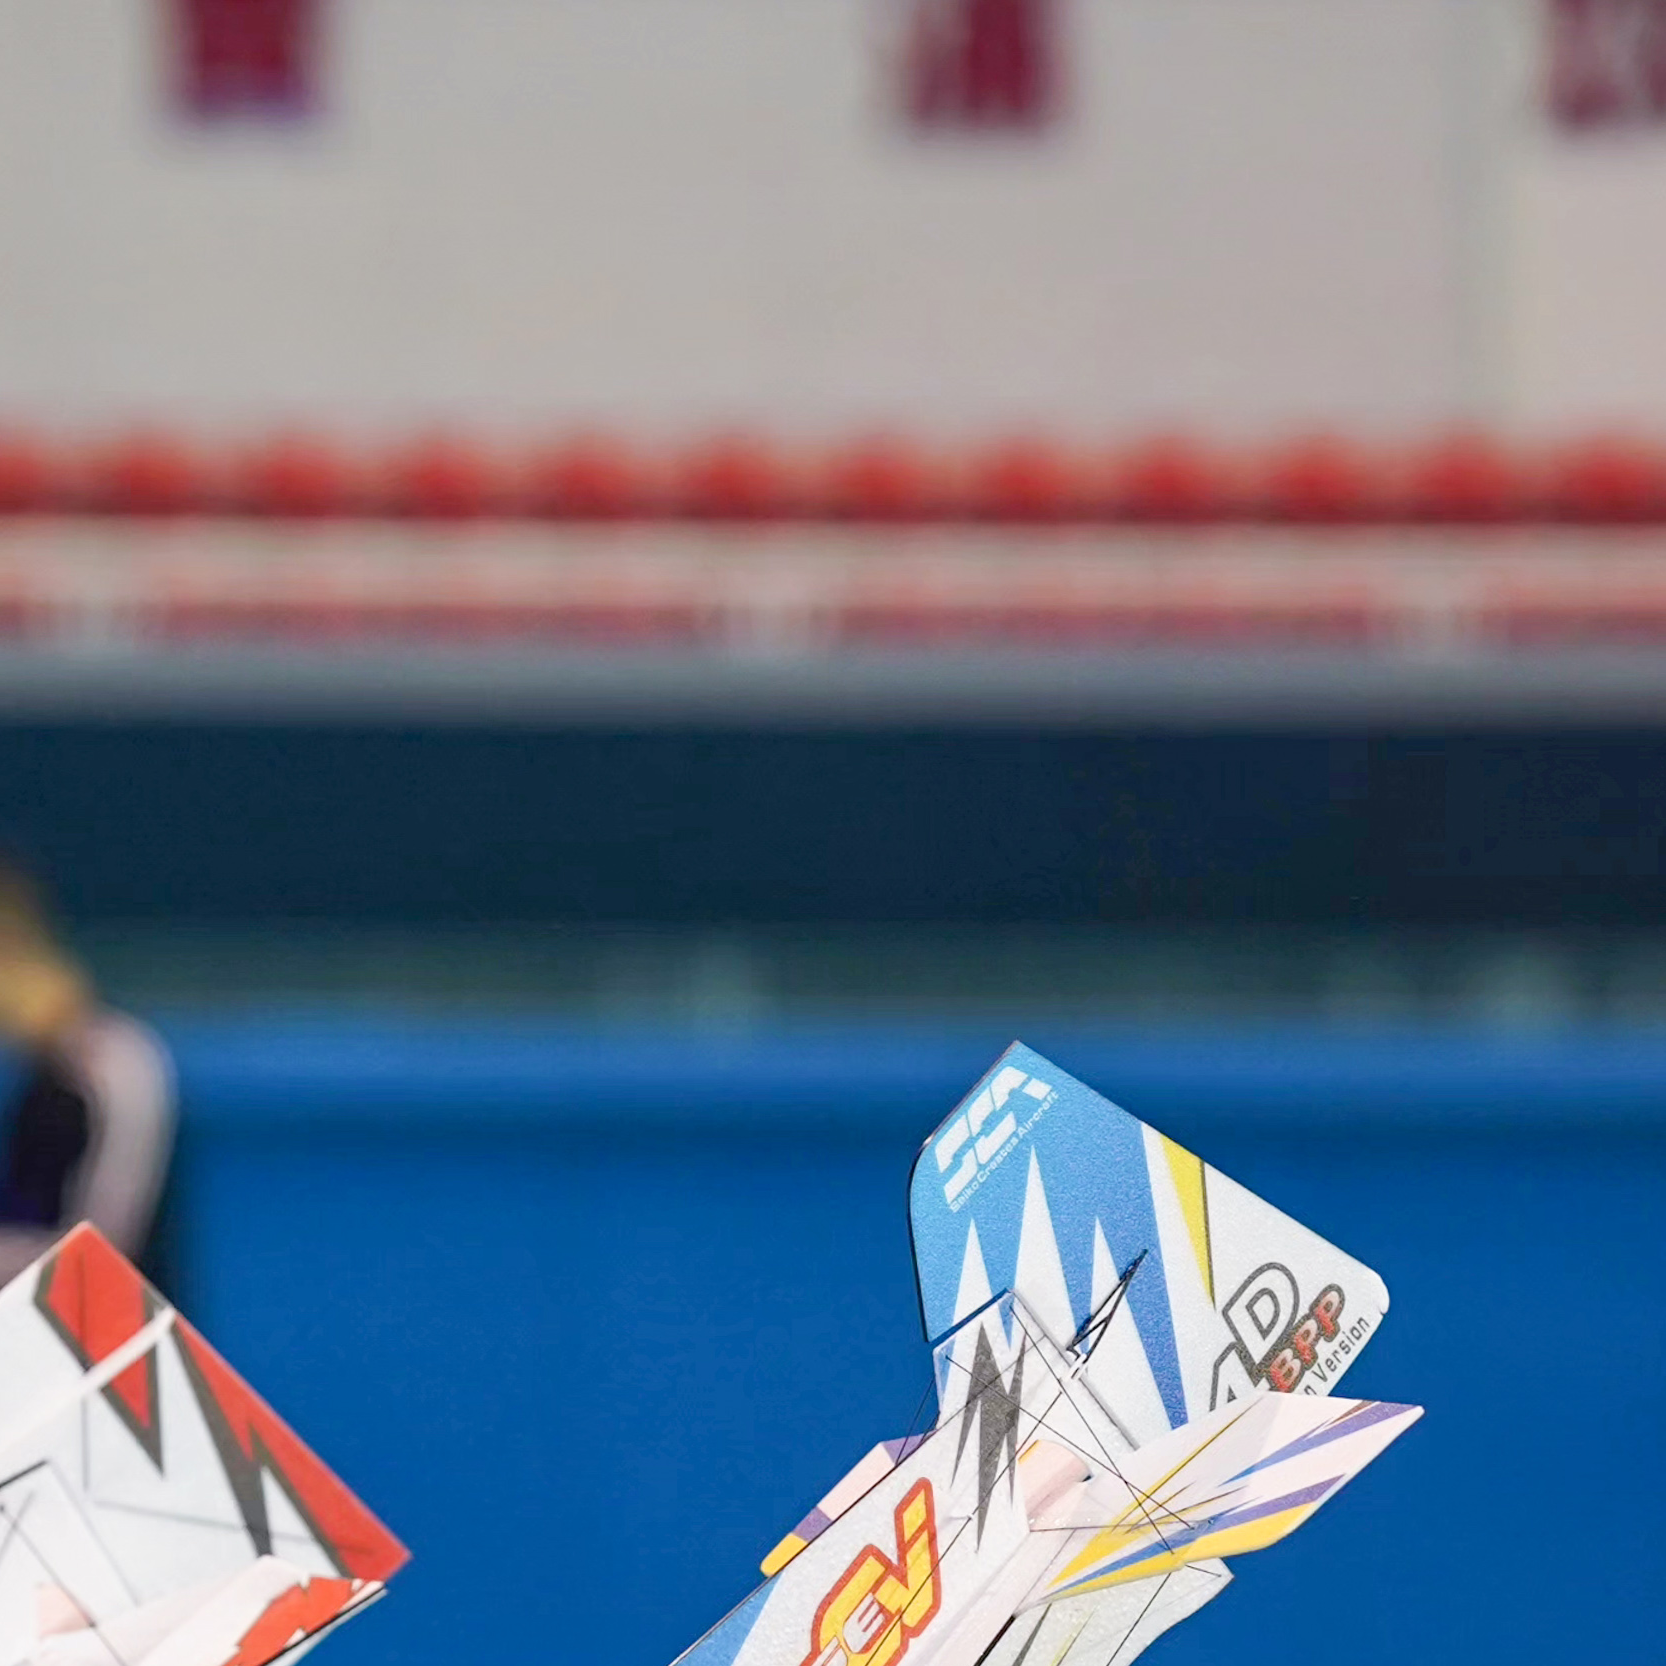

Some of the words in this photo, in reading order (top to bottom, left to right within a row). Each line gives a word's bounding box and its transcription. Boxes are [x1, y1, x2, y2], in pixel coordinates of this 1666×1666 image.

[977, 1135, 1019, 1183] Creates
[1017, 1090, 1060, 1139] Aircraft
[1312, 1316, 1371, 1383] Version
